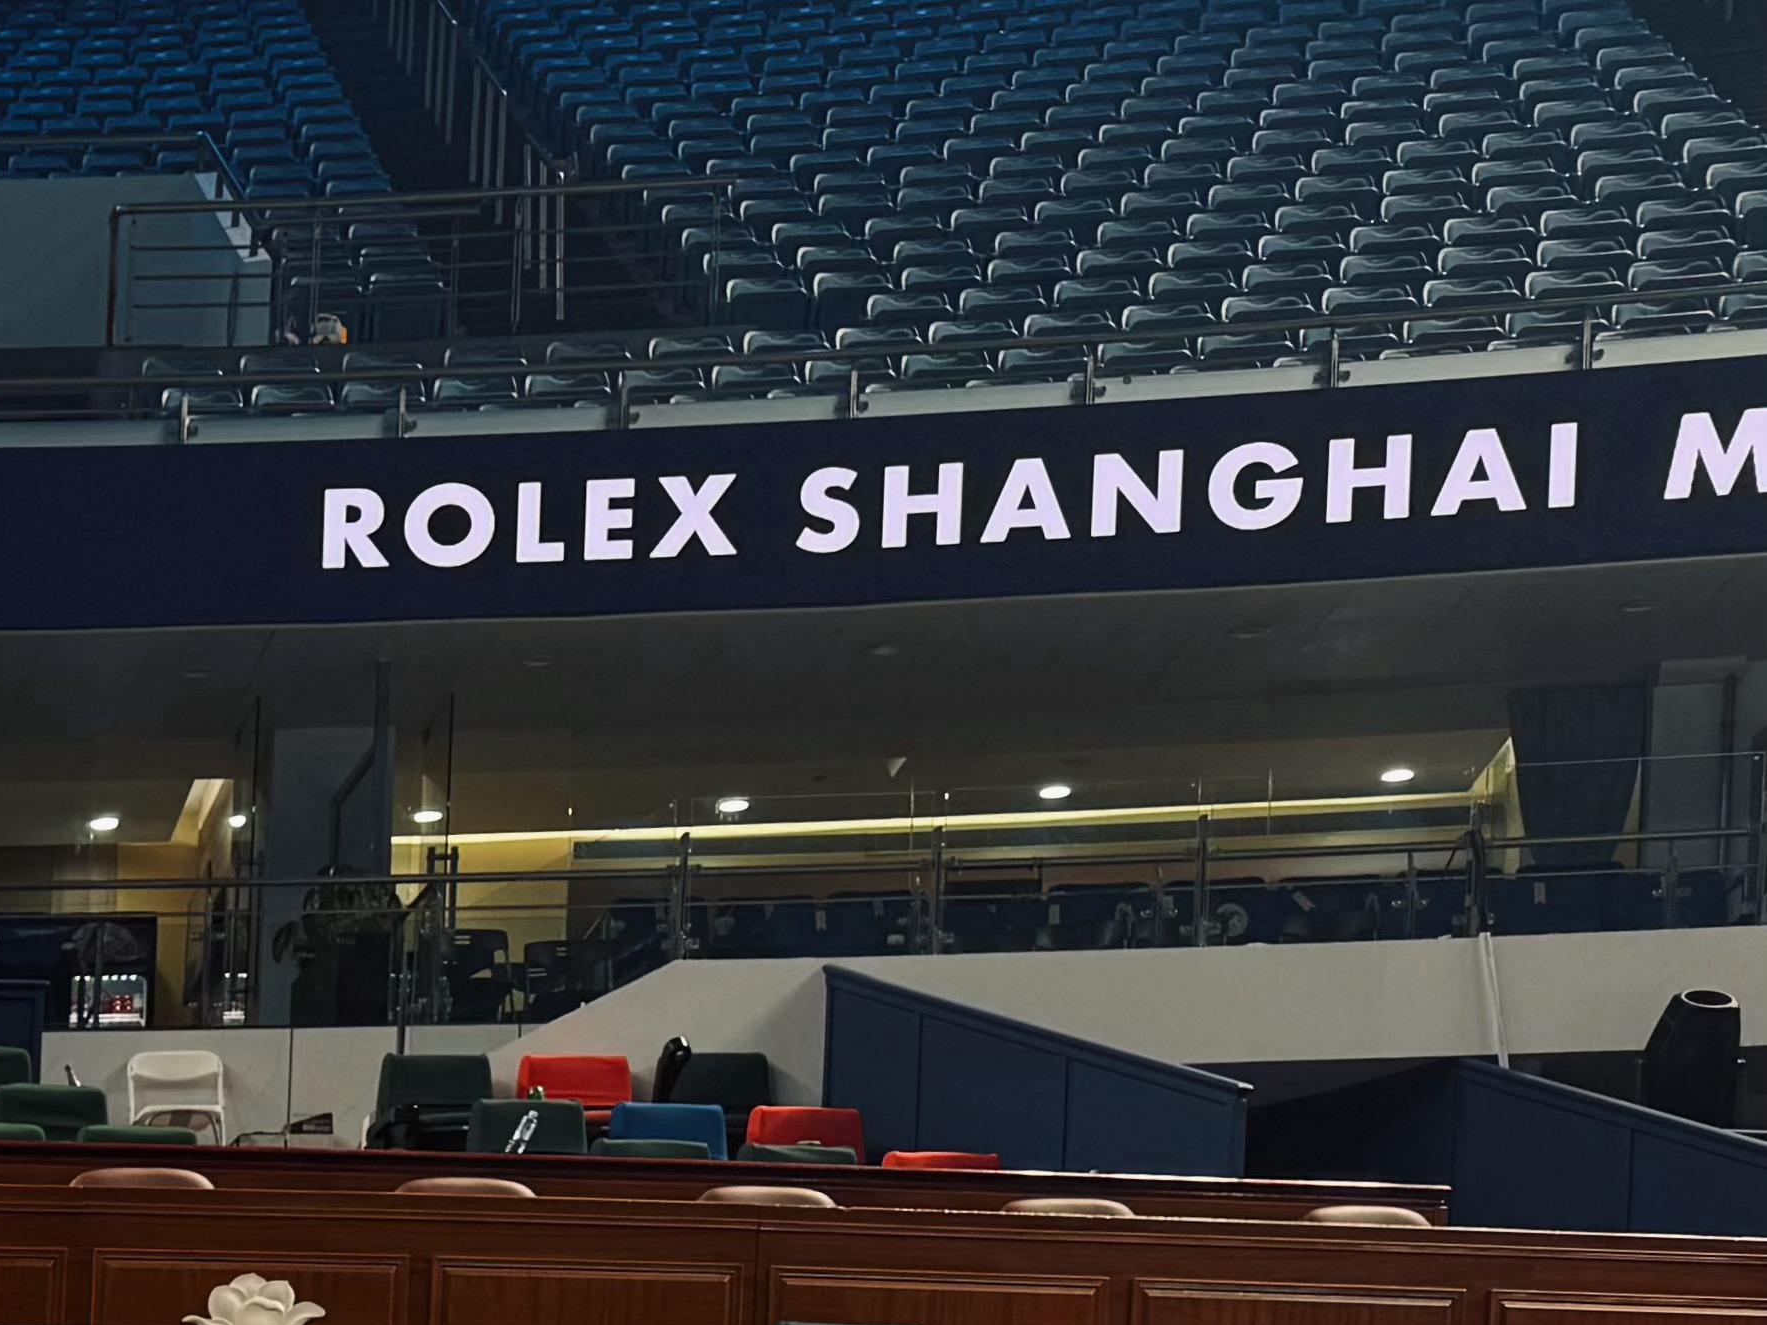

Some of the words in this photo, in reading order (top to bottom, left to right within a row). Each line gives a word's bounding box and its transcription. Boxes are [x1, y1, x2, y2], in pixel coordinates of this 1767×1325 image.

[322, 473, 737, 569] ROLEX
[795, 420, 1578, 554] SHANGHAI
[1663, 407, 1767, 500] M
